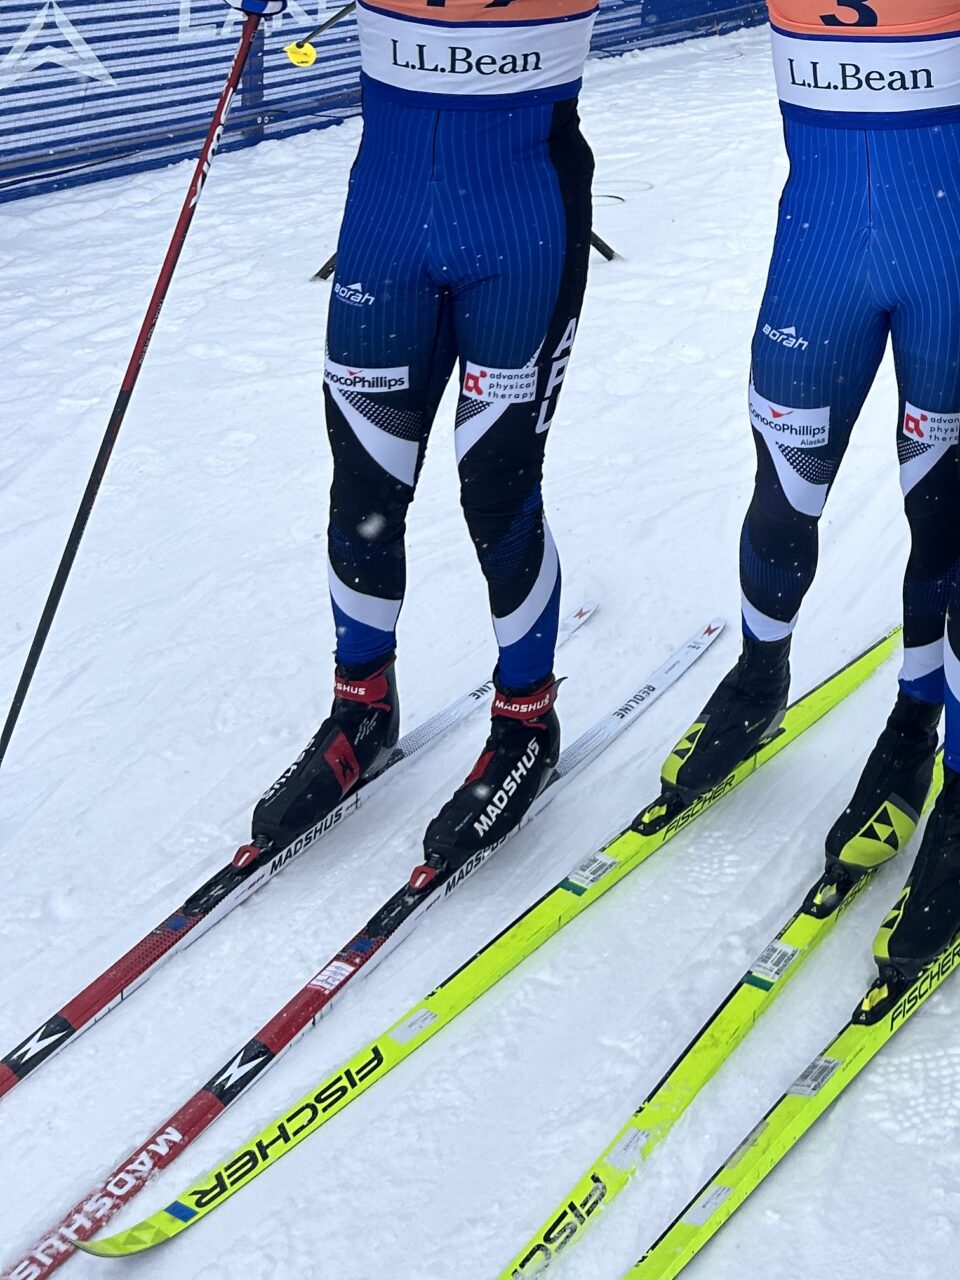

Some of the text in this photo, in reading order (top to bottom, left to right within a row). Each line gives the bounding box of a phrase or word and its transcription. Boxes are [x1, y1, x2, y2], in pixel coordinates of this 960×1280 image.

[391, 39, 542, 76] L.L.Bean
[787, 58, 935, 91] L.L.Bean
[488, 380, 536, 391] physical
[489, 371, 536, 380] advanced
[488, 391, 535, 401] therapy
[495, 694, 550, 713] MADSHUS
[612, 684, 656, 720] REDLINE
[473, 737, 540, 838] MADSHUS
[663, 774, 736, 842] FISCHER
[269, 806, 344, 876] MADSHUS
[188, 1045, 385, 1209] FISCHER
